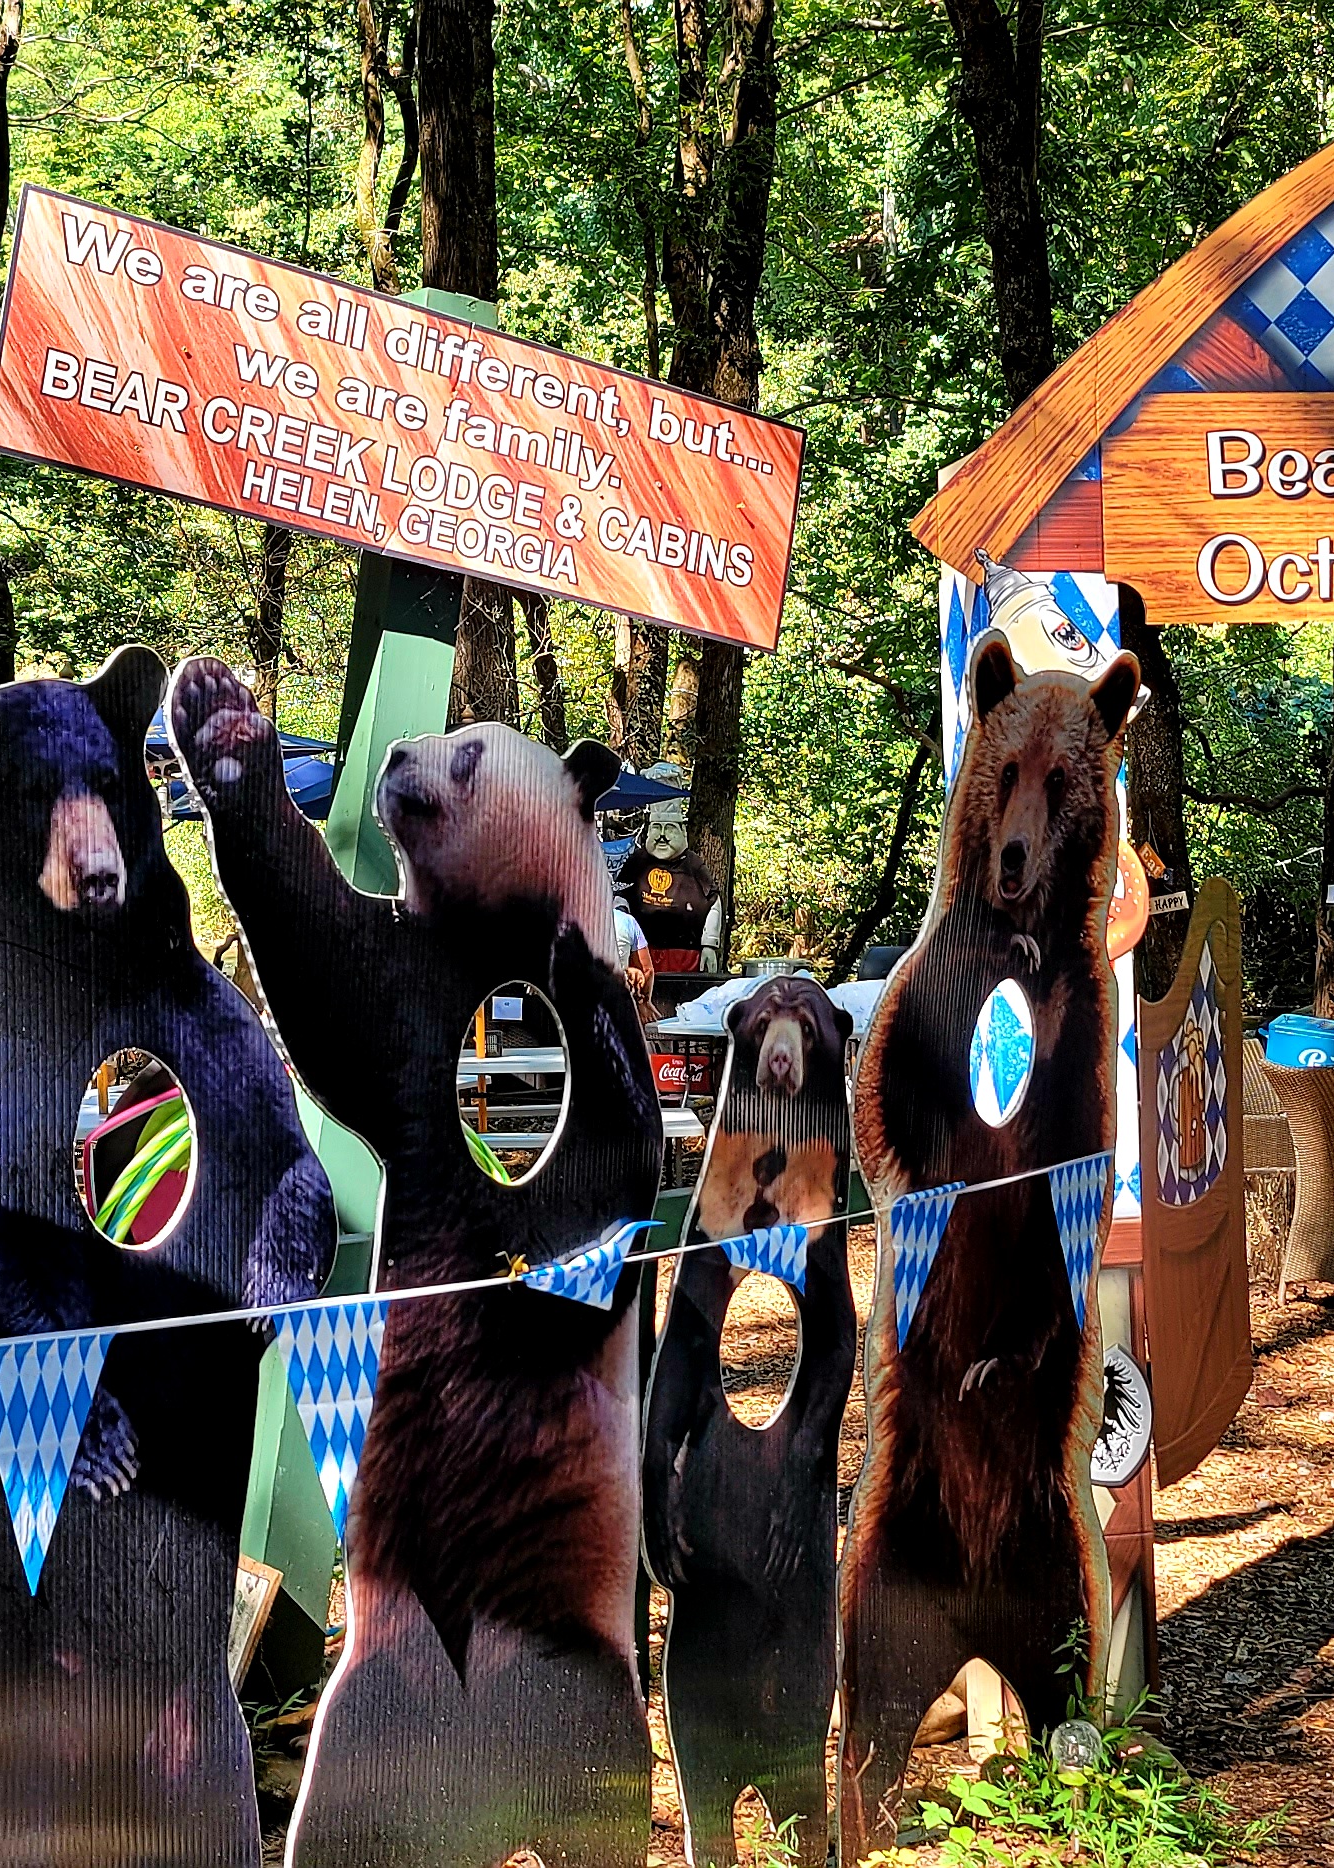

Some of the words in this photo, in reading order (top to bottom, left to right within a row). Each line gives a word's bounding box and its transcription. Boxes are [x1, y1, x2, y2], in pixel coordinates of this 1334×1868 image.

[61, 212, 163, 286] We
[180, 264, 280, 322] are
[296, 299, 370, 351] all
[385, 322, 631, 437] different,
[648, 398, 774, 475] but...
[41, 347, 189, 434] BEAR
[202, 395, 377, 484] CREEK
[381, 446, 547, 531] LODGE
[555, 494, 585, 544] &
[597, 507, 754, 588] CABINS
[234, 344, 319, 399] we
[336, 376, 428, 430] are
[444, 399, 622, 491] family.
[242, 460, 387, 541] HELEN,
[399, 505, 579, 586] GEORGIA
[1155, 895, 1184, 911] HAPPY
